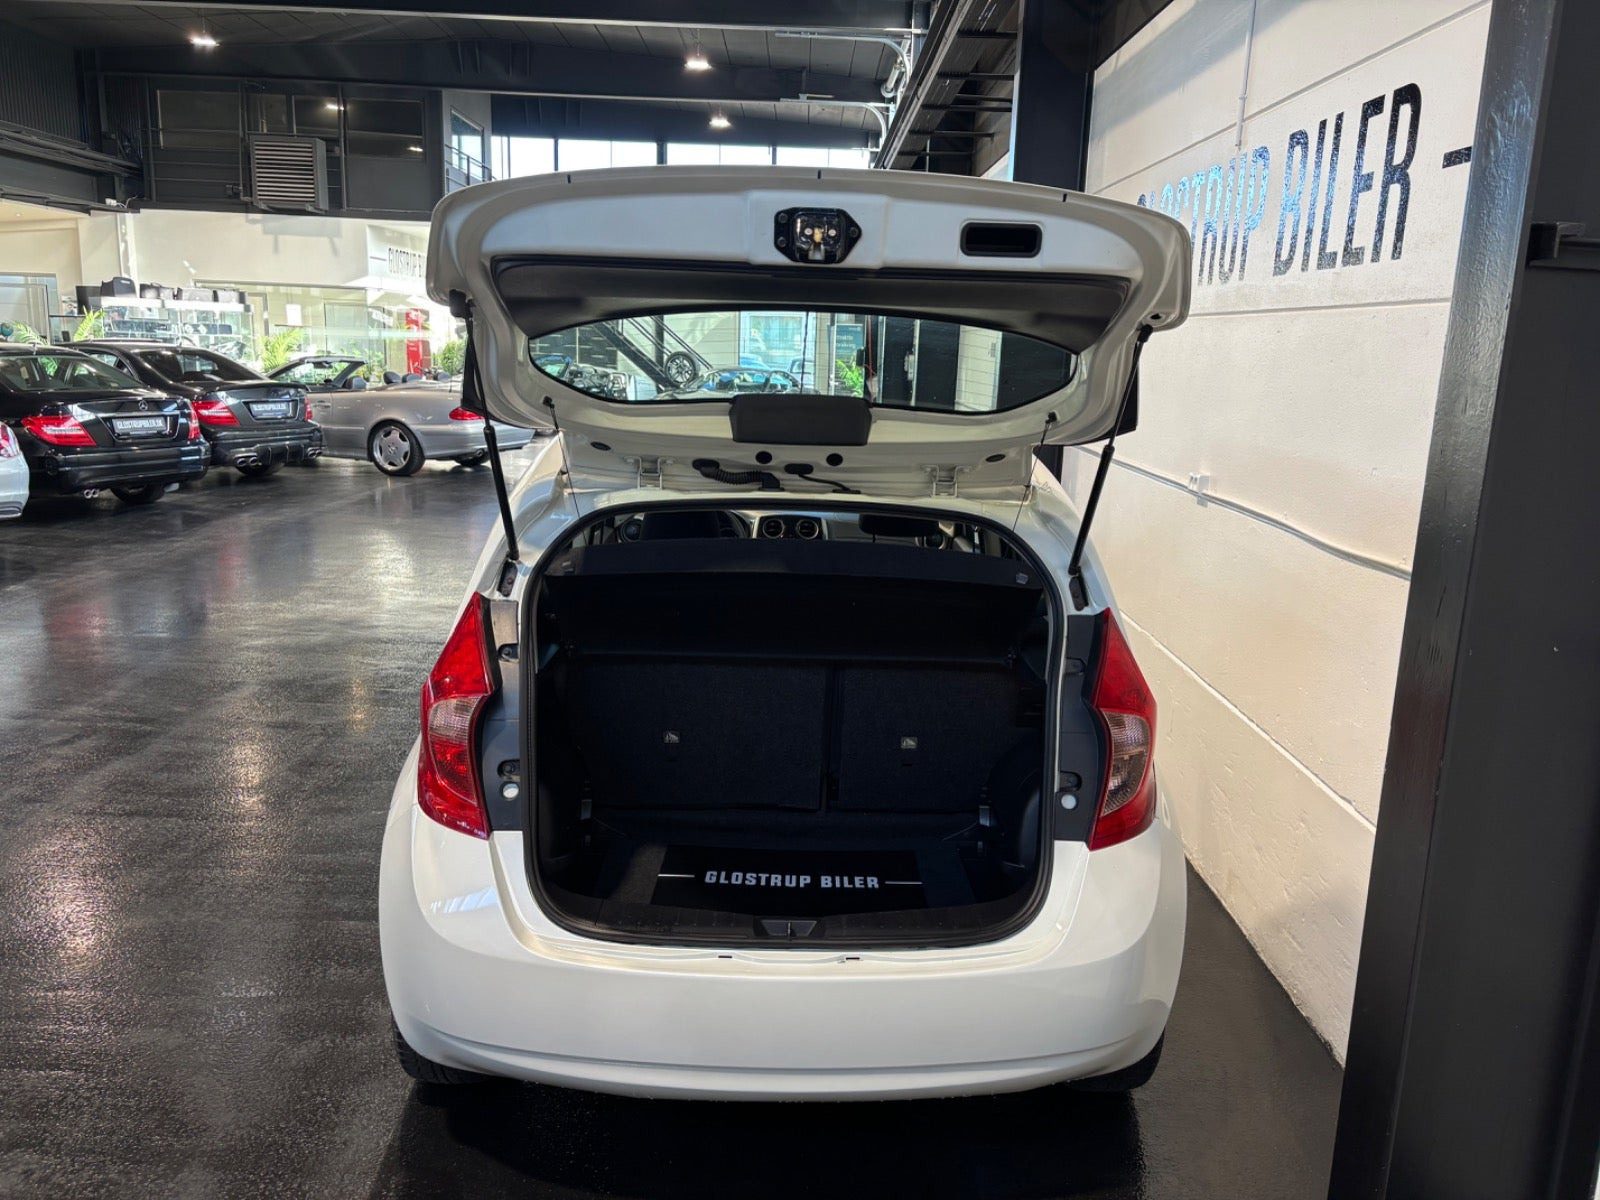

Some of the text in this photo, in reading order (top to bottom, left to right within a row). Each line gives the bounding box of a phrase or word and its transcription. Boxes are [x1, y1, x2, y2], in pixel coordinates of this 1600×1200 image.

[1273, 83, 1422, 277] BILER
[705, 871, 879, 889] GLOSTRUP BILER
